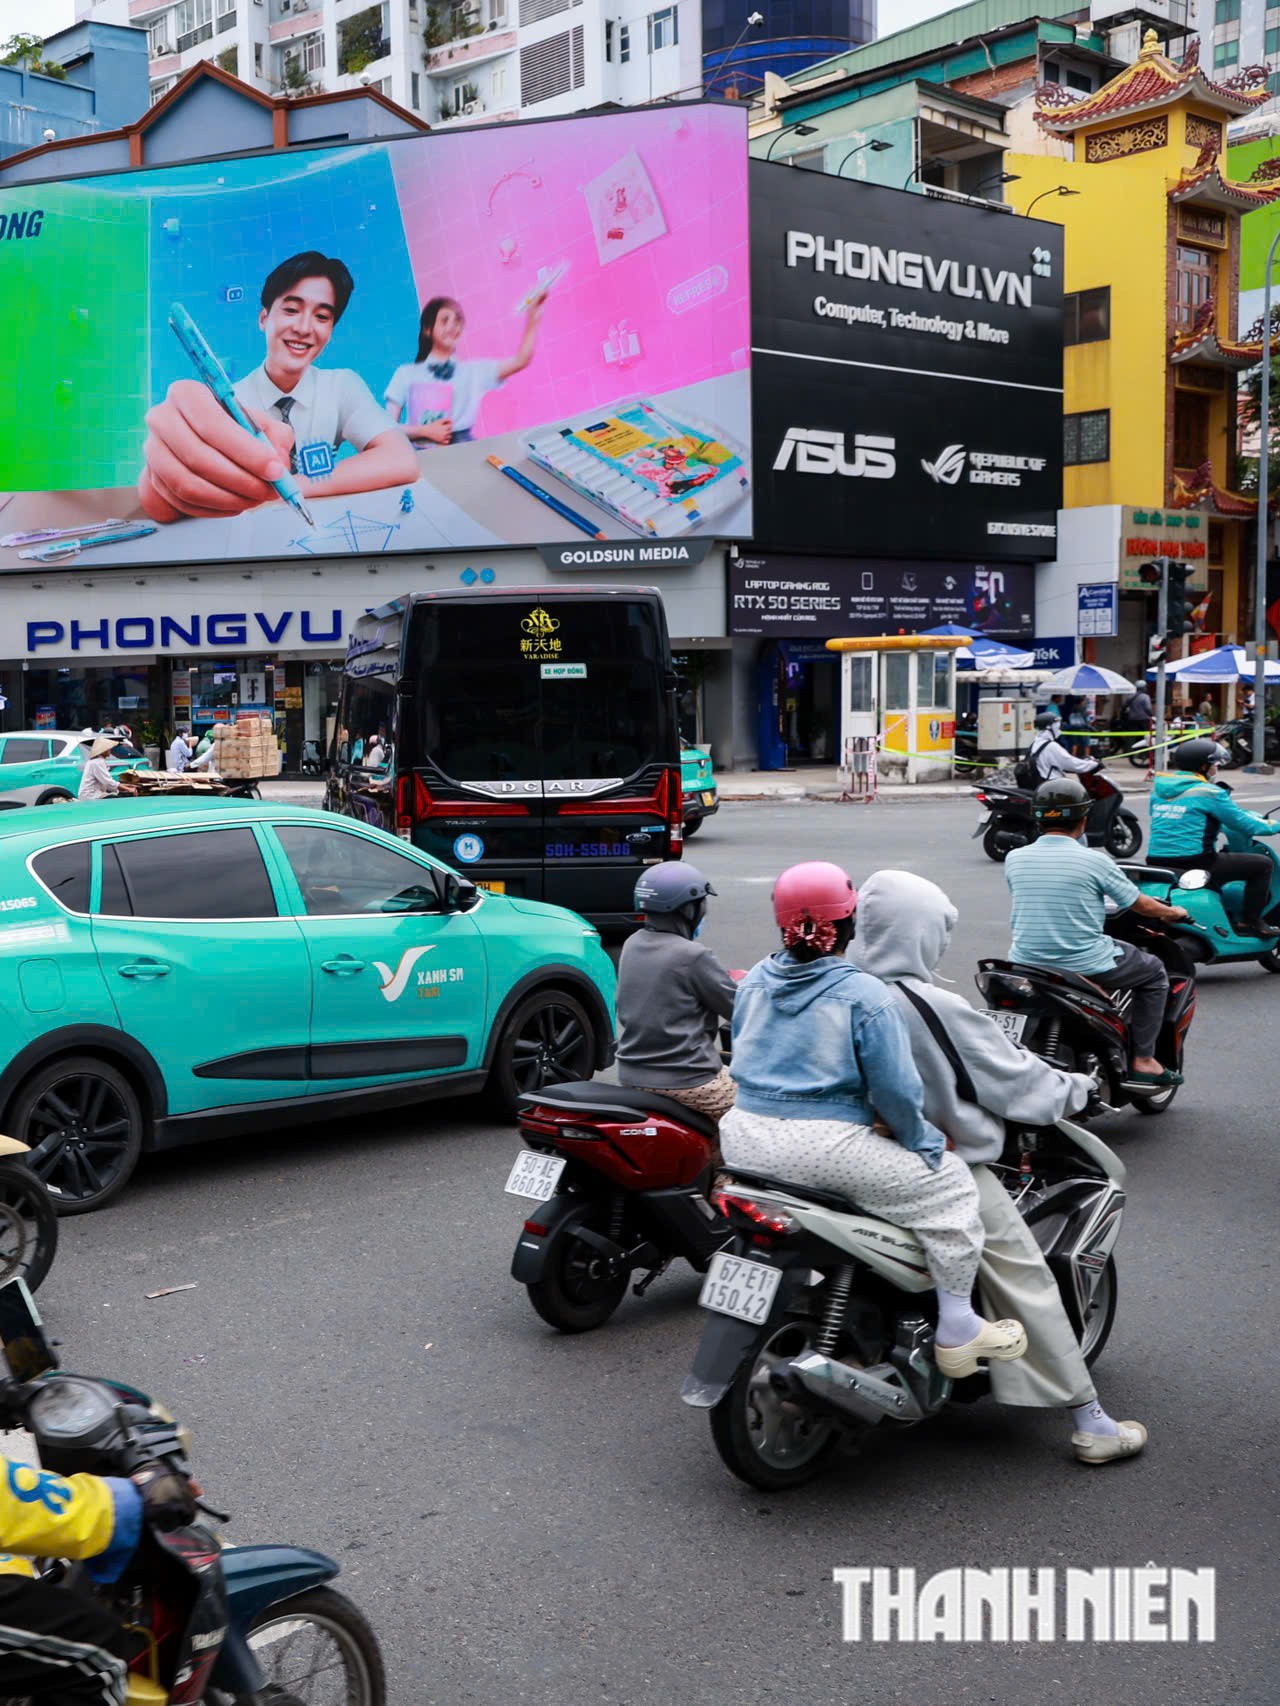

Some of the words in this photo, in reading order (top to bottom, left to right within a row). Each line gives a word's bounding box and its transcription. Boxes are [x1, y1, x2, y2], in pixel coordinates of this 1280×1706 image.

[786, 230, 1032, 308] PHONGVU.VN
[814, 296, 887, 329] Computer,
[889, 307, 963, 341] Technology
[965, 320, 977, 340] &
[977, 324, 1010, 345] More
[773, 428, 896, 479] ASUS
[970, 470, 1021, 486] GAMERS
[560, 549, 634, 564] GOLDSUN
[639, 546, 689, 561] MEDIA
[734, 595, 766, 609] RTX
[768, 596, 787, 609] 50
[790, 597, 841, 610] SERIES
[26, 609, 342, 652] PHONGVU
[520, 638, 563, 652] 新天地
[500, 780, 585, 793] DCAR
[417, 969, 447, 985] XANH
[449, 968, 464, 982] SM
